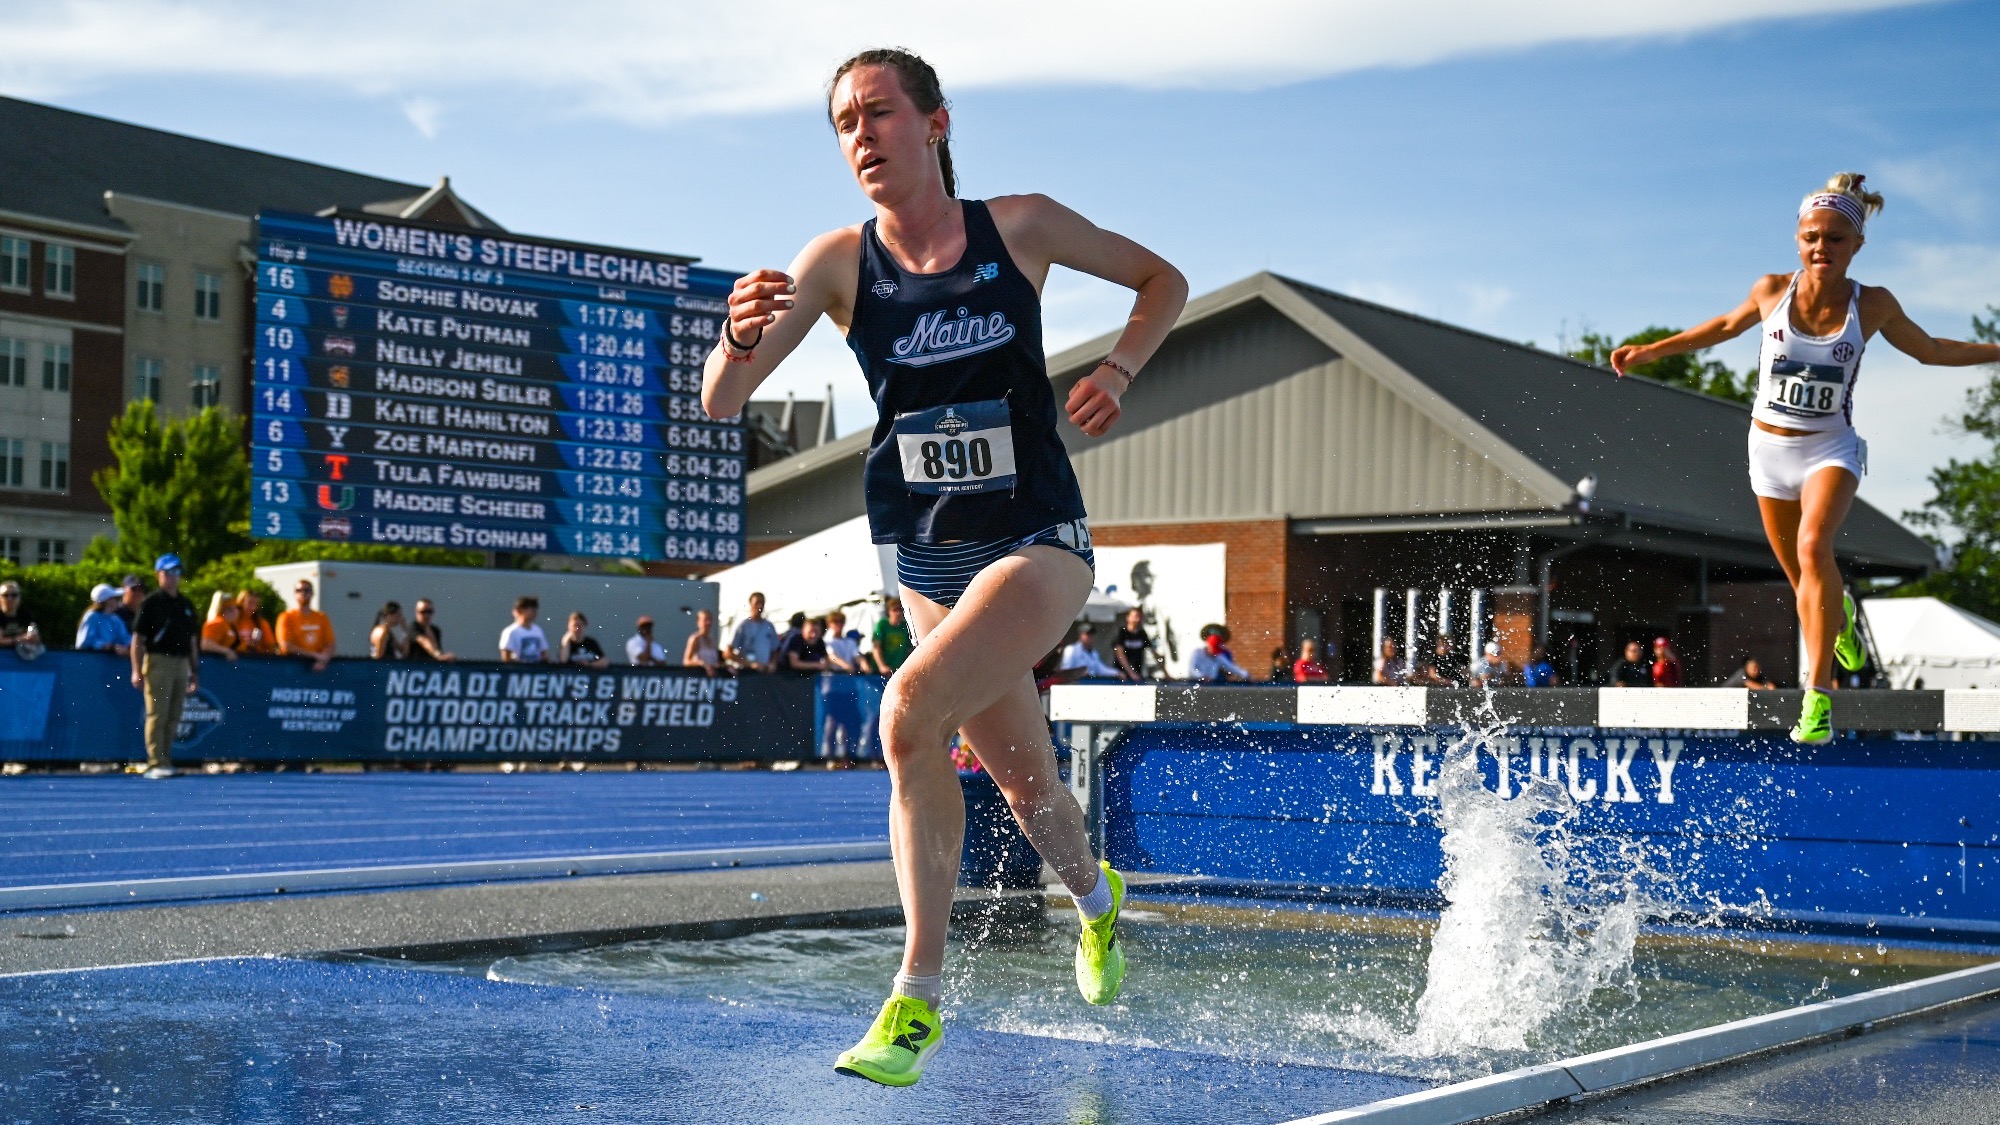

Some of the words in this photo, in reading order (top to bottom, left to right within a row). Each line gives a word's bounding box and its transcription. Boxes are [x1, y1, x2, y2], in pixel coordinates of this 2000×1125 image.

[334, 218, 473, 261] WOMEN'S
[480, 236, 689, 290] STEEPLECHASE
[396, 259, 459, 280] SECTION
[266, 266, 295, 290] 16
[377, 280, 458, 308] SOPHIE
[461, 290, 539, 318] NOVAK
[578, 304, 646, 330] 1:17.94
[670, 314, 719, 340] 5:48.
[270, 299, 288, 320] 4
[376, 309, 437, 337] KATE
[441, 317, 532, 347] PUTMAN
[577, 332, 645, 360] 1:20.44
[890, 306, 1010, 360] Maine
[1834, 343, 1853, 361] SEC
[263, 357, 291, 381] 11
[375, 367, 477, 399] MADISON
[481, 378, 551, 406] SEILER
[264, 327, 294, 350] 10
[375, 338, 446, 368] NELLY
[449, 347, 523, 376] JEMELI
[577, 359, 645, 387] 1:20.78
[1776, 379, 1834, 410] 1018
[262, 388, 292, 413] 14
[374, 398, 440, 426] KATIE
[443, 405, 550, 436] HAMILTON
[667, 425, 742, 451] 6:04.13
[267, 420, 284, 443] 6
[373, 429, 422, 453] ZOE
[425, 434, 536, 462] MARTONFI
[575, 447, 643, 472] 1:22.52
[666, 454, 741, 480] 6:04.20
[920, 437, 993, 479] 890
[267, 450, 283, 472] 5
[372, 460, 433, 485] TULA
[437, 465, 542, 492] FAWBUSH
[575, 474, 642, 499] 1:23.43
[666, 481, 741, 506] 6:04.36
[261, 481, 289, 504] 13
[373, 489, 456, 514] MADDIE
[459, 495, 546, 520] SCHEIER
[574, 502, 641, 527] 1:23.21
[665, 508, 740, 535] 6:04.58
[266, 512, 281, 535] 3
[372, 517, 447, 544] LOUISE
[450, 522, 548, 550] STONHAM
[665, 536, 740, 562] 6:04.69
[270, 687, 331, 704] HOSTED
[331, 689, 356, 705] BY:
[386, 670, 462, 698] NCAA
[467, 672, 502, 698] DI
[506, 673, 591, 699] MEN'S
[595, 675, 616, 699] &
[621, 675, 739, 702] WOMEN'S
[267, 706, 339, 720] UNIVERSITY
[340, 708, 358, 721] OF
[281, 719, 343, 733] KENTUCKY
[385, 699, 518, 725] OUTDOOR
[523, 701, 612, 726] TRACK
[616, 703, 637, 726] &
[641, 703, 716, 728] FIELD
[384, 727, 623, 753] CHAMPIONSHIPS
[1370, 733, 1685, 804] KETUCKY
